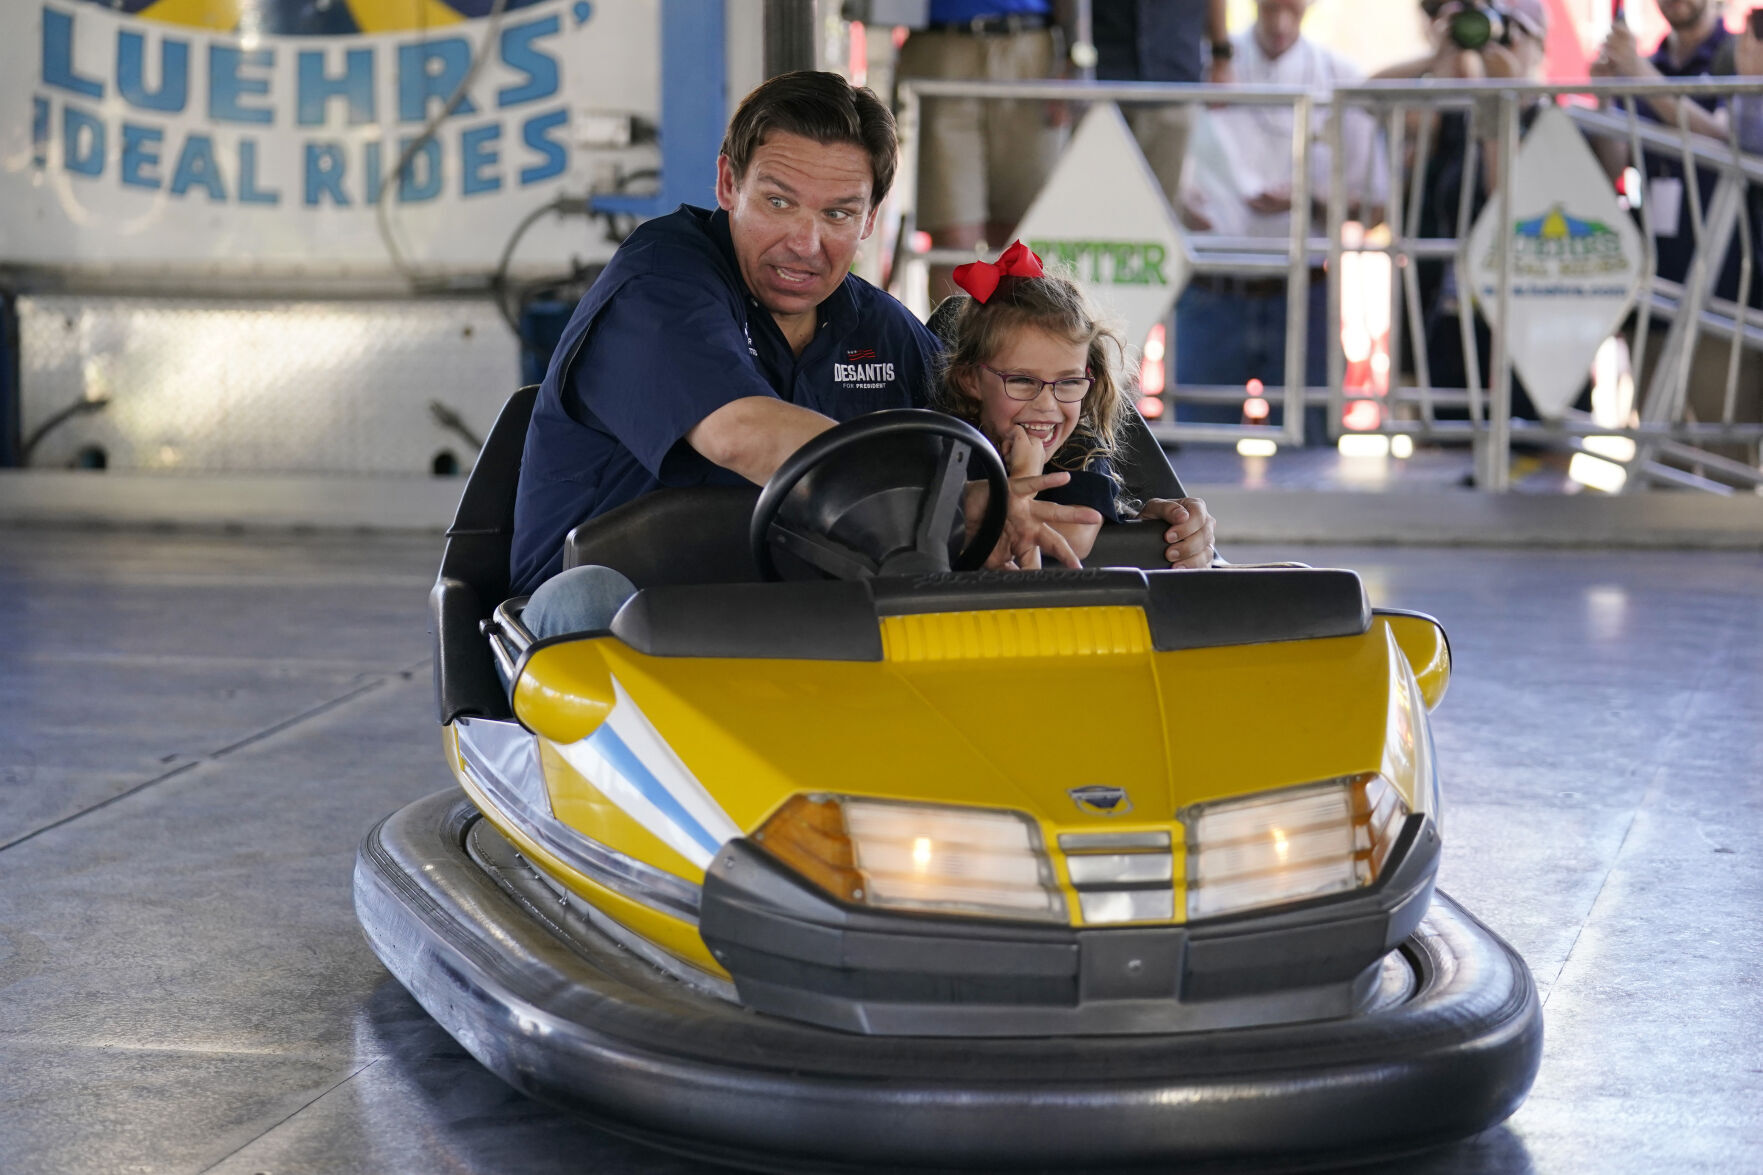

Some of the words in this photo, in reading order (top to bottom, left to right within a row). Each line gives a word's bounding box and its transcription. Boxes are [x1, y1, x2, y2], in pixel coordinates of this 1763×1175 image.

[40, 0, 594, 126] LUEHRS'
[303, 108, 570, 207] RIDES
[834, 363, 895, 381] DESANTIS
